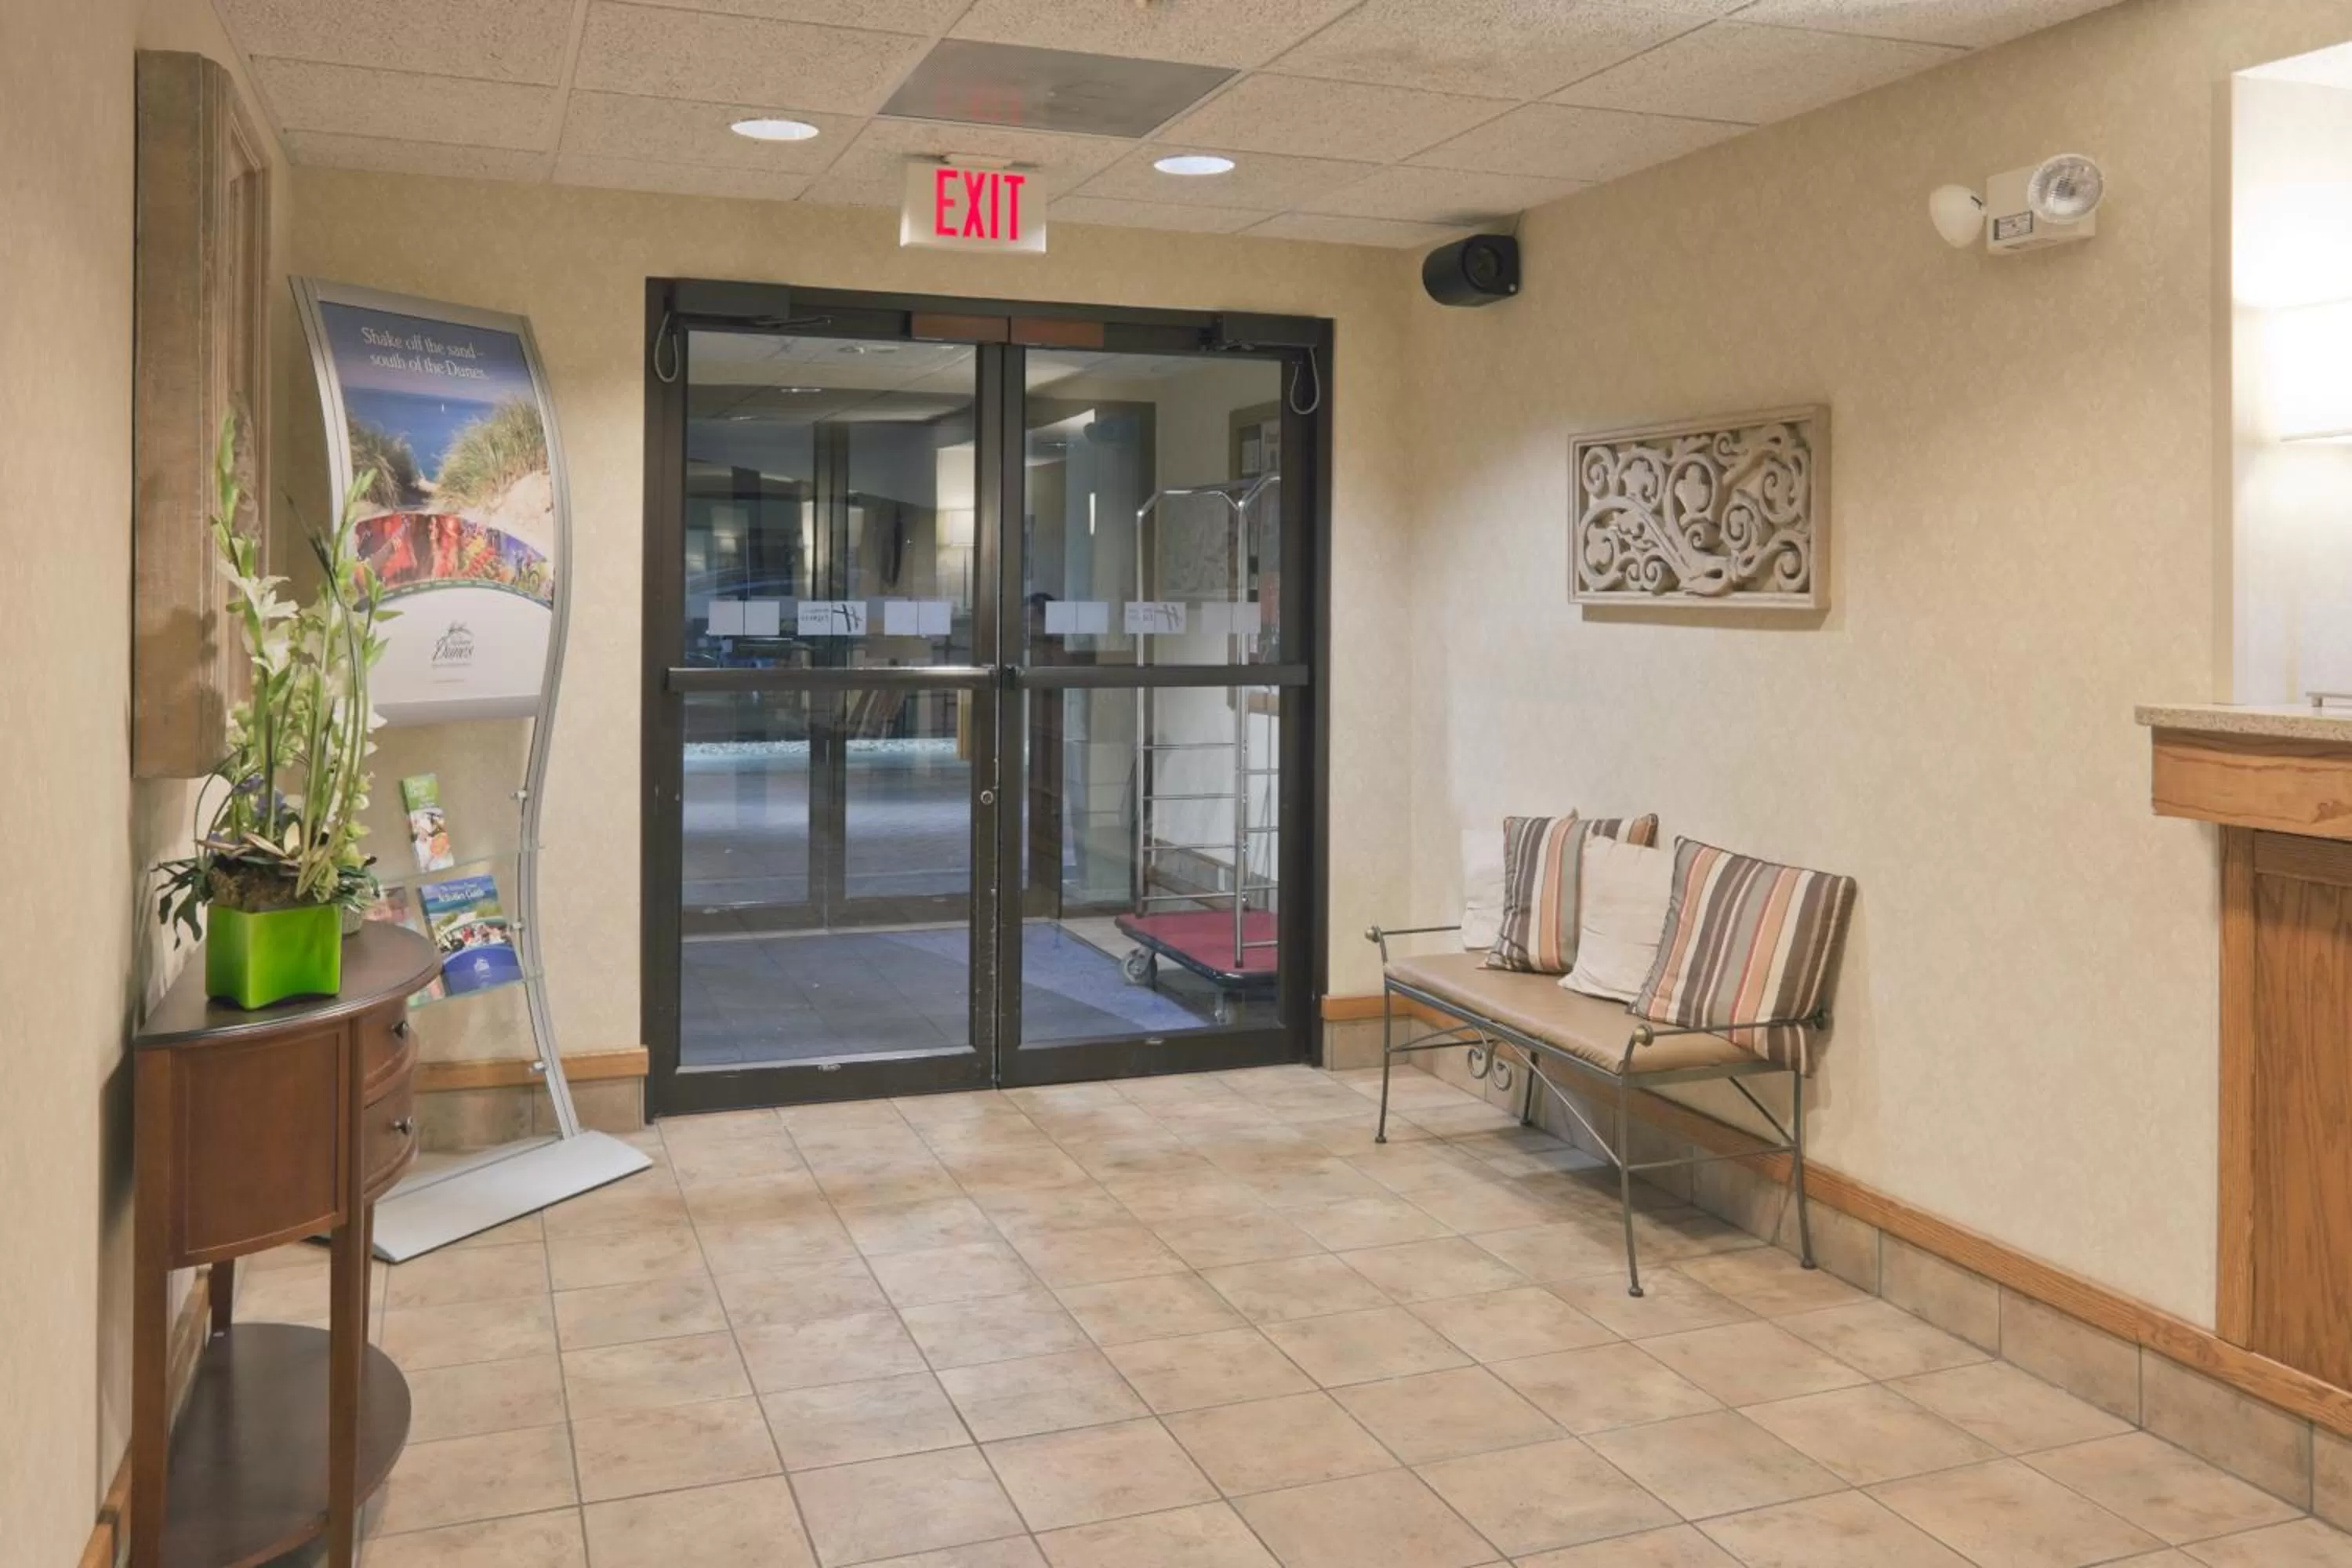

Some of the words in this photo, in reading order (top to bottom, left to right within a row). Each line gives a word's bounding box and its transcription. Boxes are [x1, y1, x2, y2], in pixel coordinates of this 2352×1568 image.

[935, 168, 1025, 241] EXIT
[361, 325, 402, 349] Shake
[405, 333, 423, 351] off
[424, 337, 445, 354] the
[369, 352, 405, 370] south
[408, 354, 422, 372] of
[423, 357, 445, 376] the
